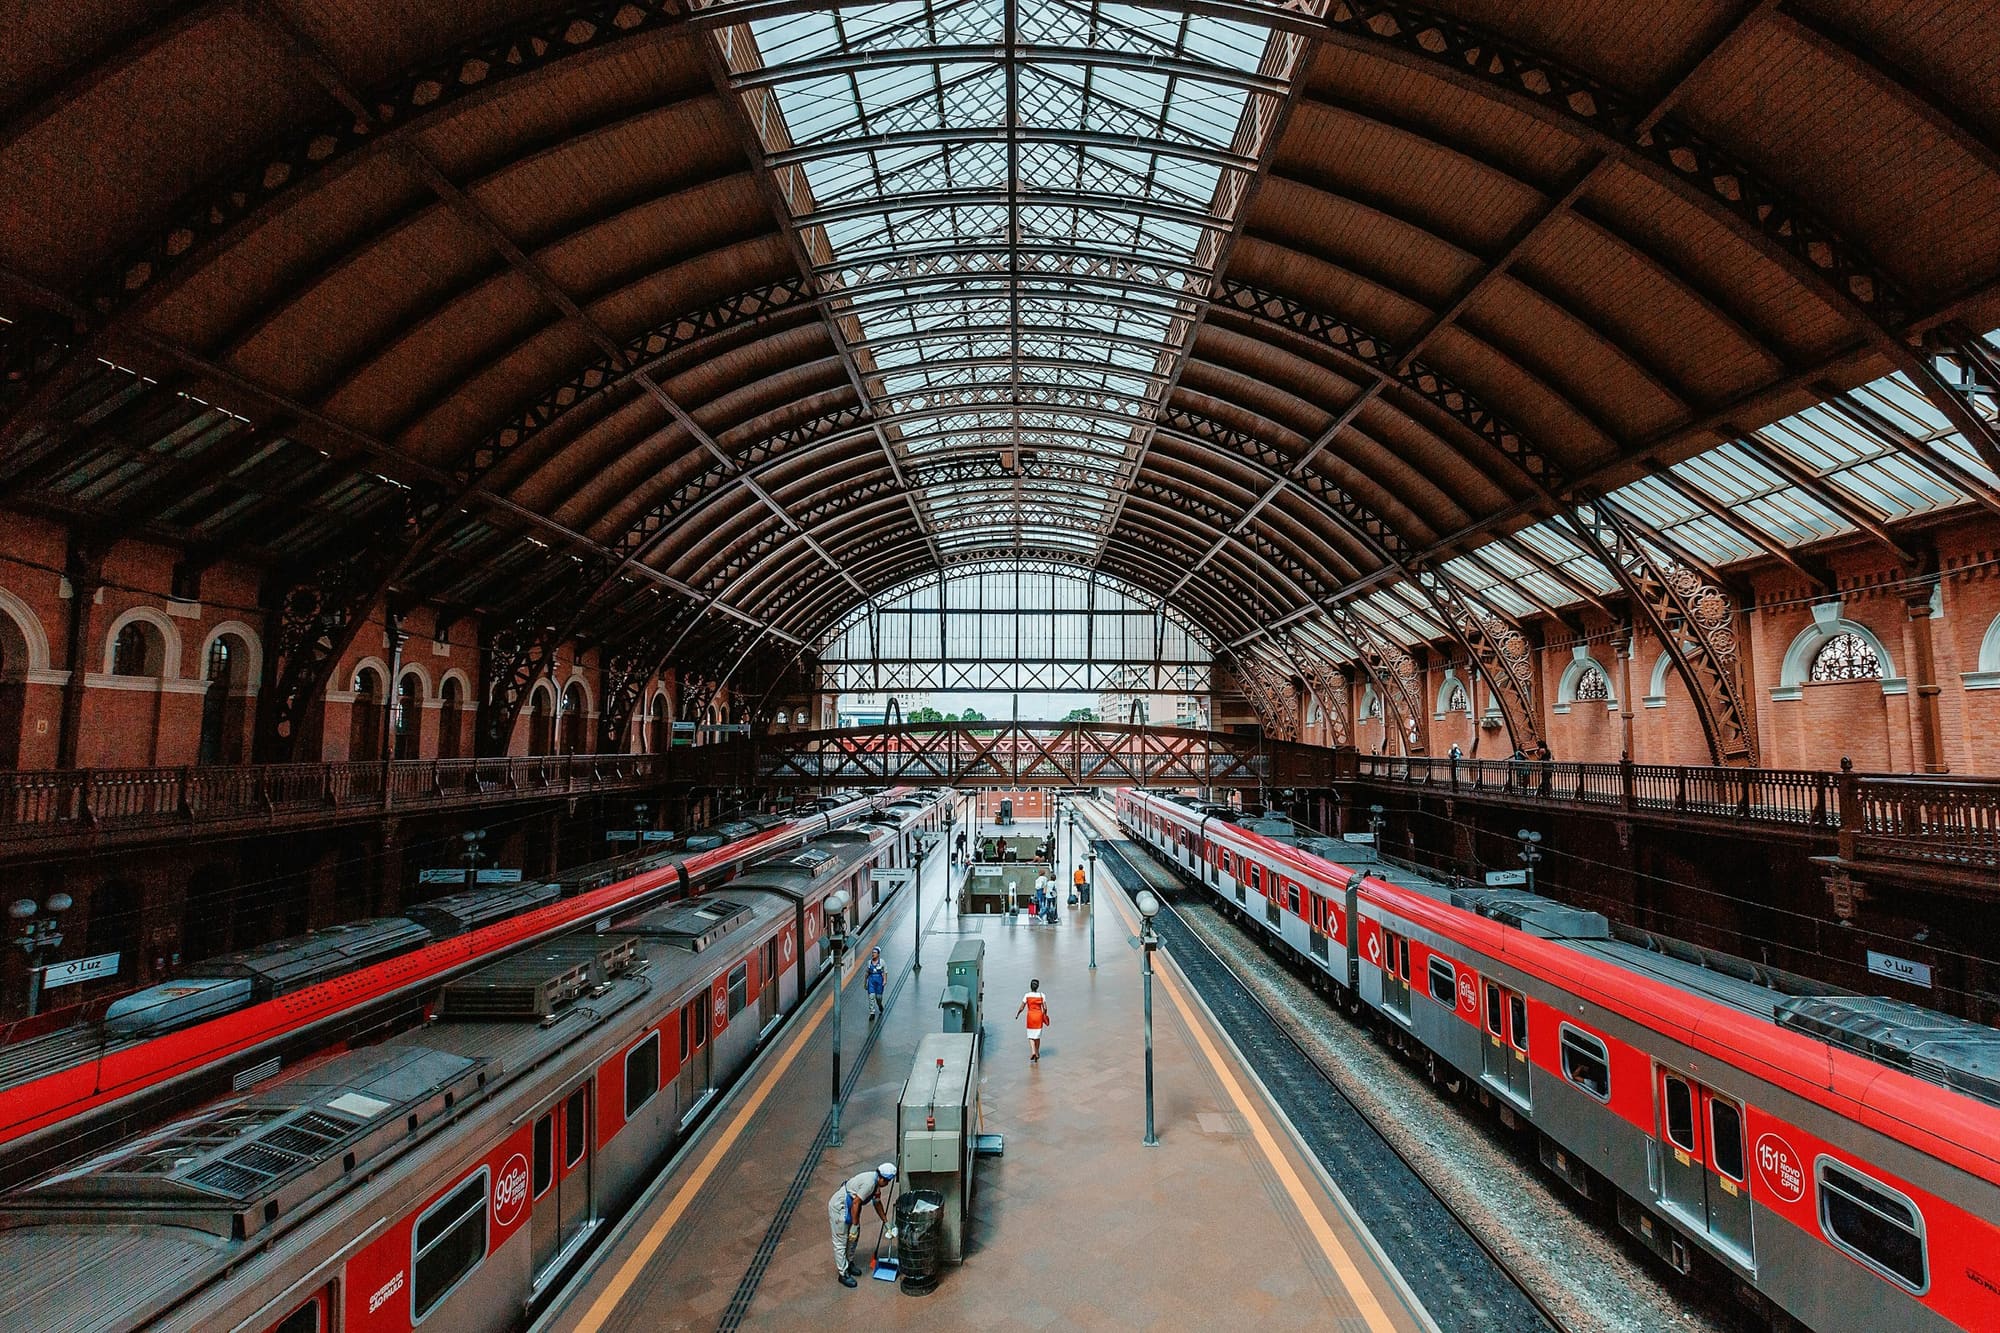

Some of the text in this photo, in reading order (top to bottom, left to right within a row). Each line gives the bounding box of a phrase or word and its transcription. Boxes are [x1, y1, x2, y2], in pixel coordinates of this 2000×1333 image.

[81, 961, 101, 971] Luz
[1895, 961, 1913, 974] Luz
[1780, 1162, 1800, 1178] NOVO
[1781, 1169, 1800, 1186] TREM
[1781, 1179, 1800, 1194] CPTM
